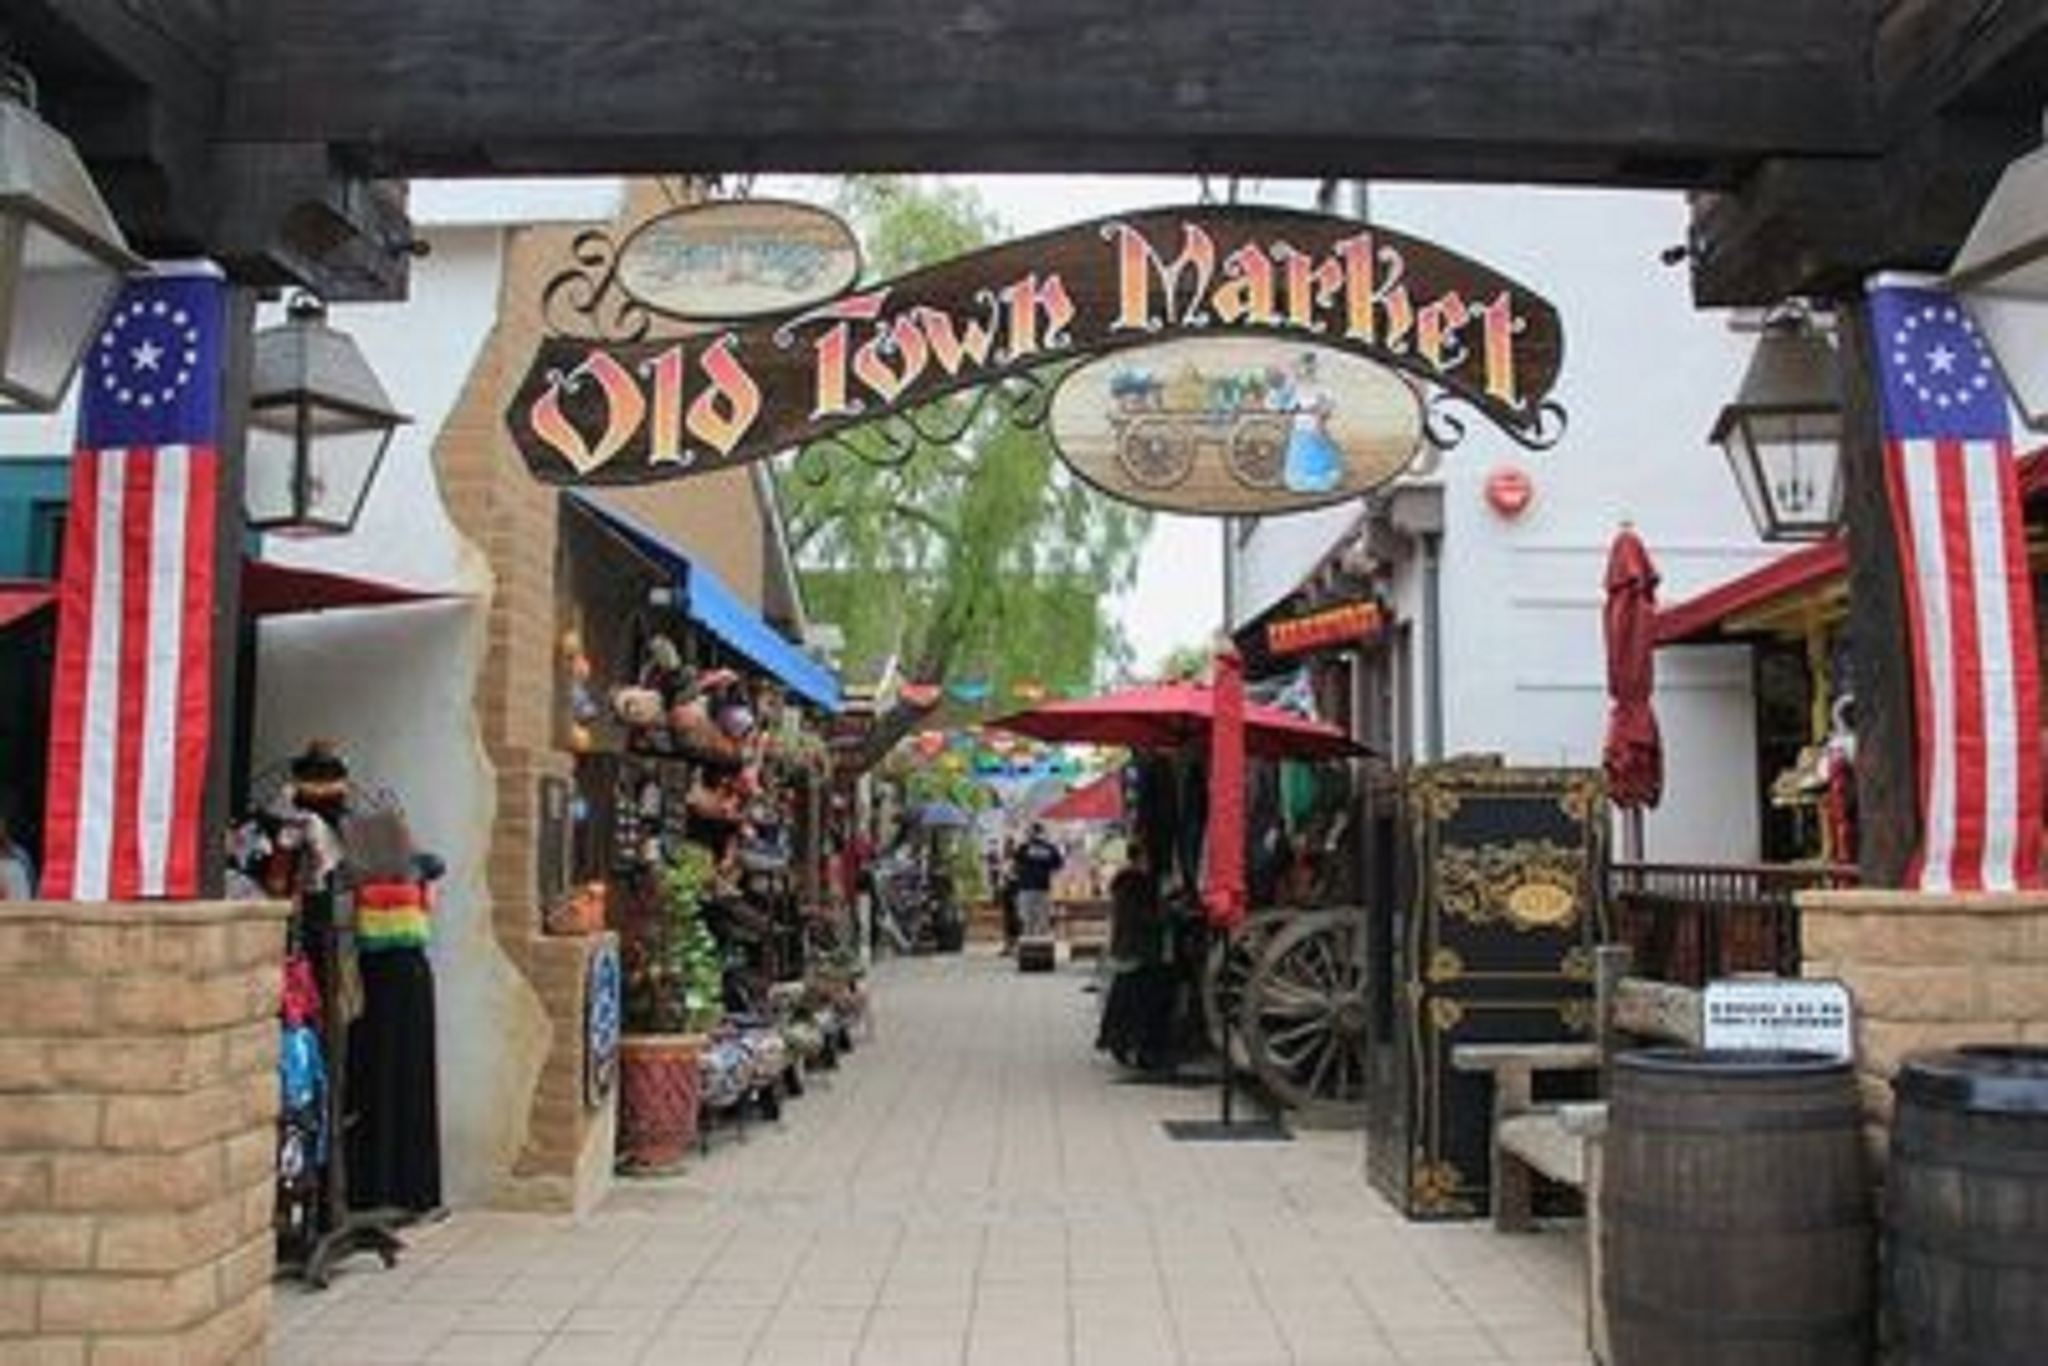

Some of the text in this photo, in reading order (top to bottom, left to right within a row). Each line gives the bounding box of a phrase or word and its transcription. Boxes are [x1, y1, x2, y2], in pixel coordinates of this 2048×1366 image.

[530, 221, 1526, 475] Old Town Market
